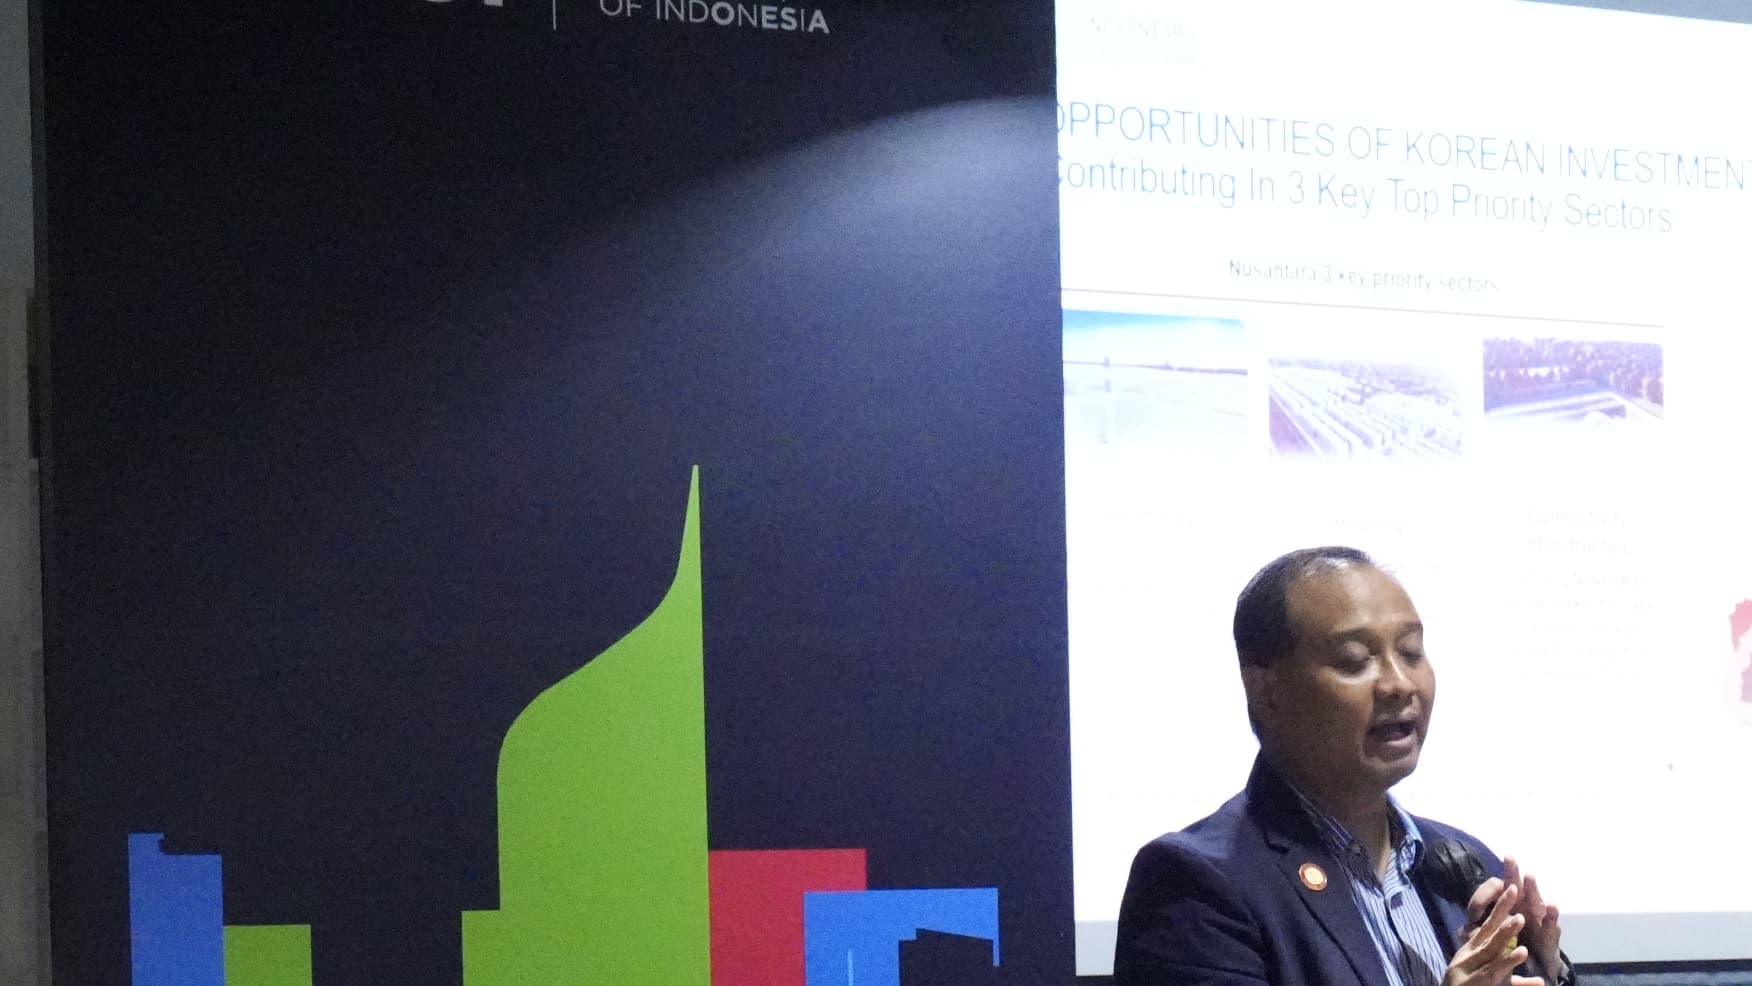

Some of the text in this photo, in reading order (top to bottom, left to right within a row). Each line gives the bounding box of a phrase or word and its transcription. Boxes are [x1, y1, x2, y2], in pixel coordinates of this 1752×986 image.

[654, 0, 830, 34] INDONESIA
[1347, 125, 1393, 161] OF
[1405, 130, 1546, 176] KOREAN
[1249, 167, 1276, 203] In
[1287, 170, 1306, 205] 3
[1318, 172, 1376, 219] Key
[1387, 177, 1440, 223] Top
[1451, 183, 1553, 233] Priority
[1562, 192, 1674, 234] Sectors
[1323, 263, 1334, 283] 3
